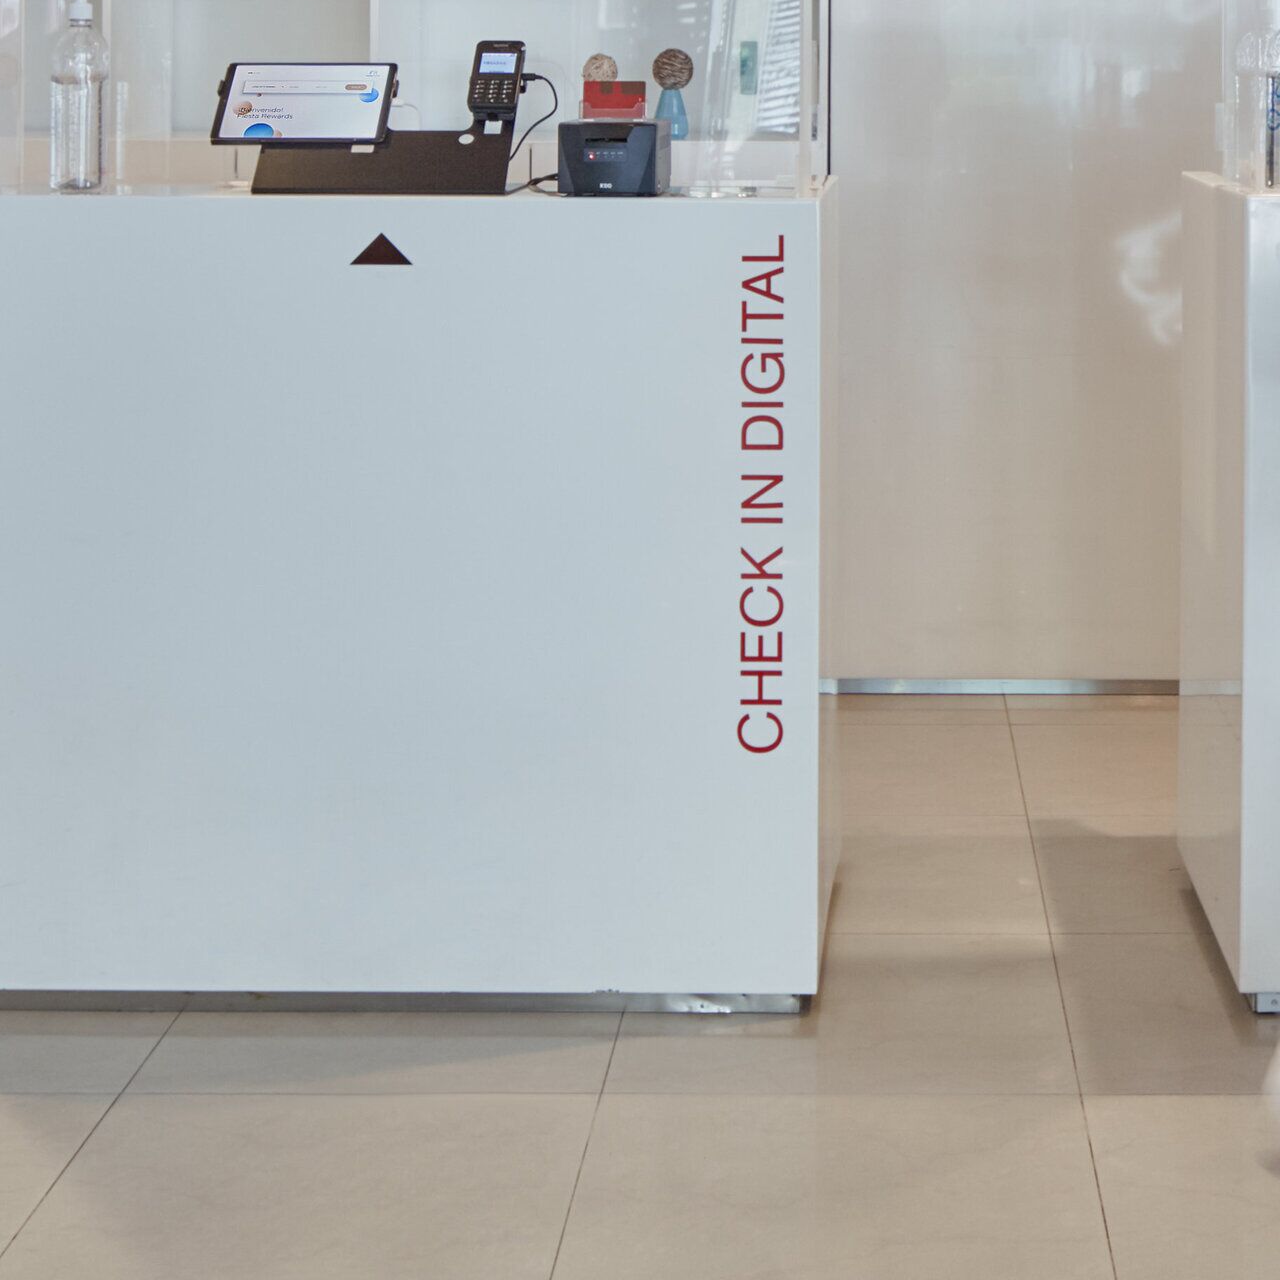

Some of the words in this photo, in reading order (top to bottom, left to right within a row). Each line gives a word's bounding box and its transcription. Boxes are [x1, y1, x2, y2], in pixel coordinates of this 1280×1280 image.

[740, 234, 786, 451] DIGITAL
[740, 474, 784, 524] IN
[736, 546, 784, 754] CHECK
